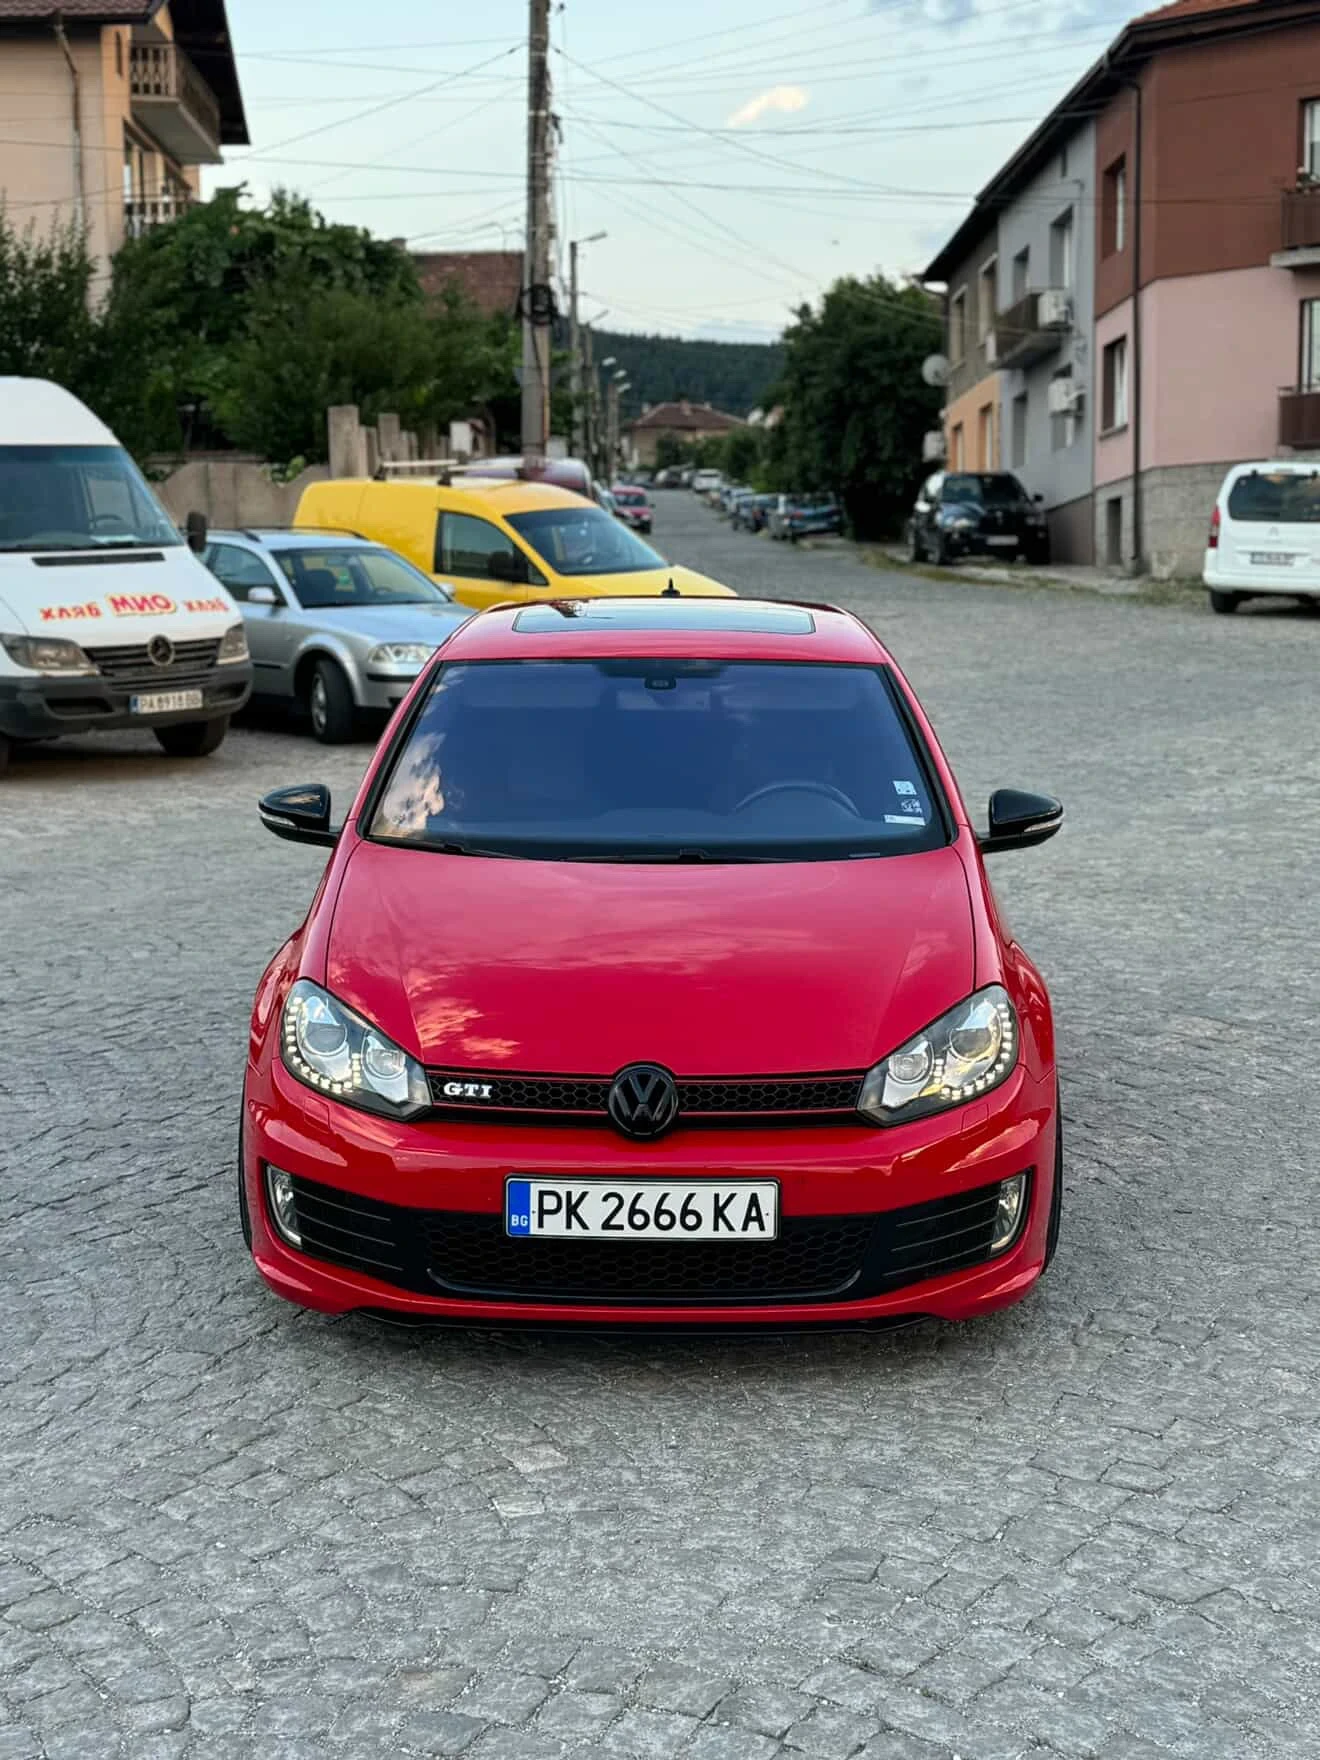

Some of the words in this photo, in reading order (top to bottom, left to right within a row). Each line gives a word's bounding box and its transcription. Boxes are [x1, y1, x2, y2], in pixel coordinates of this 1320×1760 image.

[443, 1081, 492, 1098] GTI
[537, 1189, 590, 1231] PK
[601, 1191, 703, 1232] 2666
[712, 1192, 766, 1232] KA
[511, 1214, 529, 1227] BG
